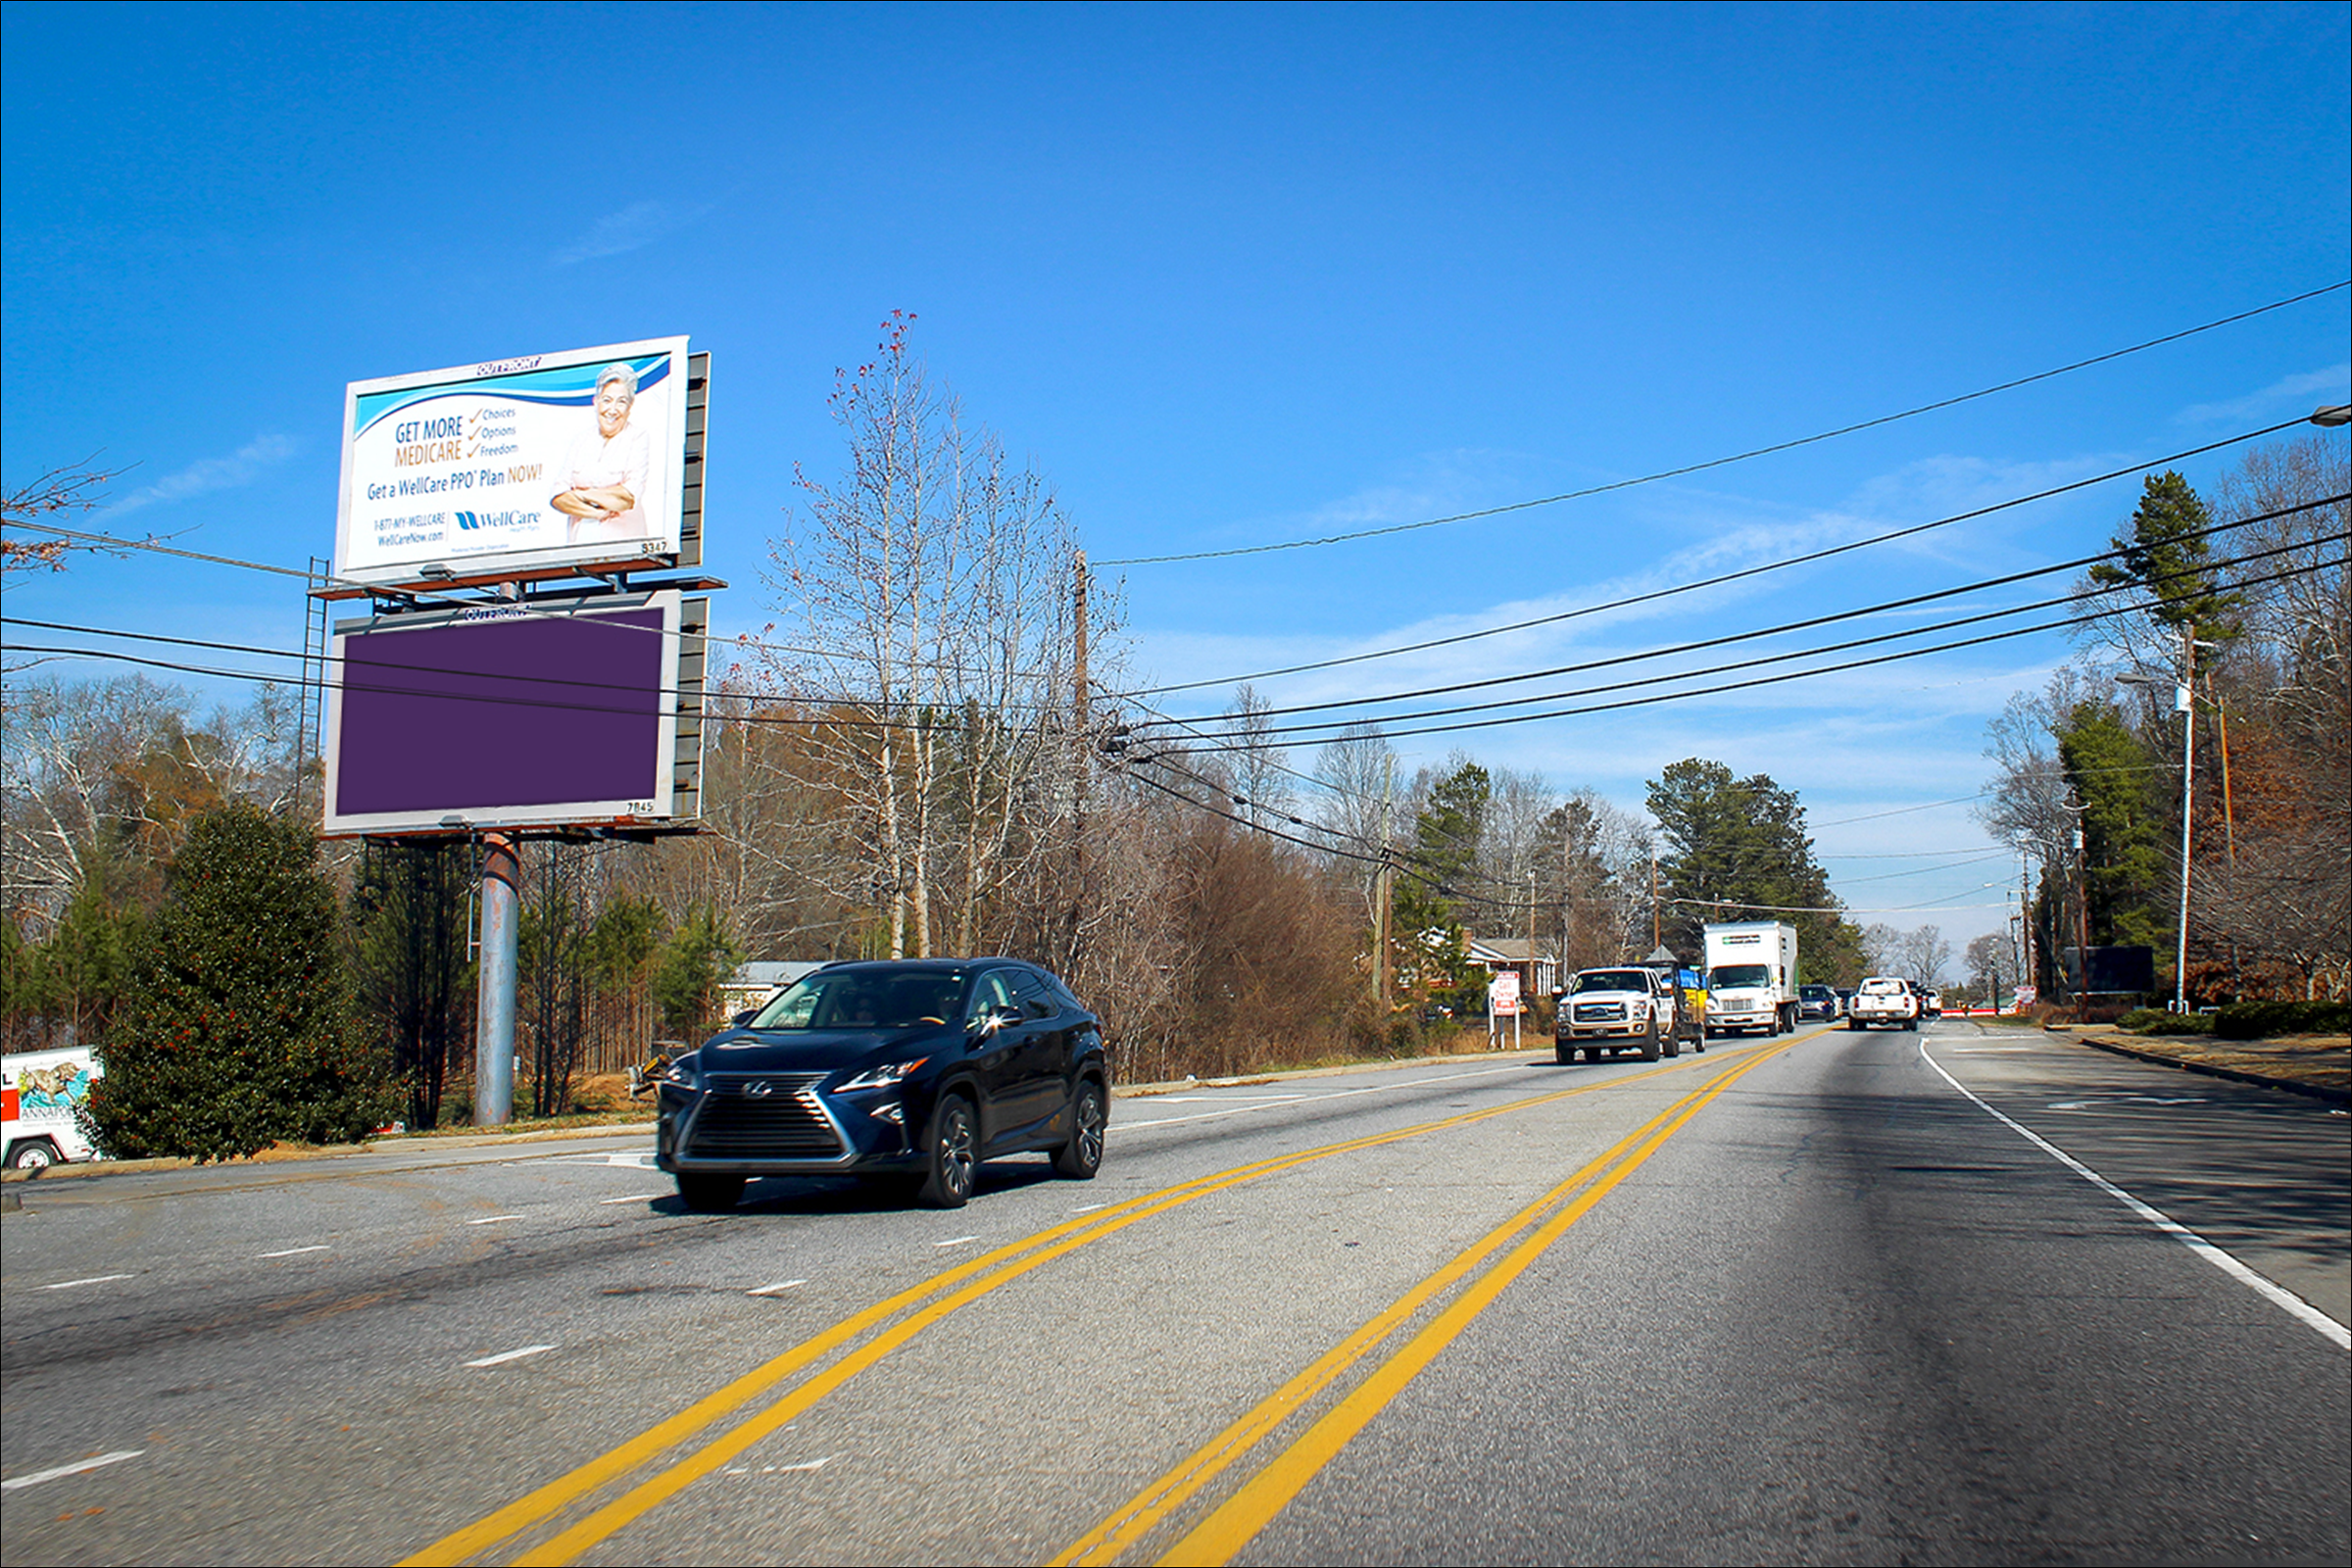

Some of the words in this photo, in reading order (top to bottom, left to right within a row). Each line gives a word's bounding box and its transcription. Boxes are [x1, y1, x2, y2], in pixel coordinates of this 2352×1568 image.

[482, 408, 516, 420] Choices
[395, 421, 420, 444] GET
[422, 416, 464, 440] MORE
[481, 425, 516, 441] Options
[394, 440, 462, 467] MEDICARE
[480, 444, 519, 457] Freedom
[368, 483, 387, 501] Get
[388, 485, 396, 498] a
[399, 476, 448, 496] WellCare
[479, 468, 505, 487] Plan
[507, 464, 543, 484] NOW!
[480, 510, 541, 527] WellCare
[377, 531, 444, 547] WellCareNow.com
